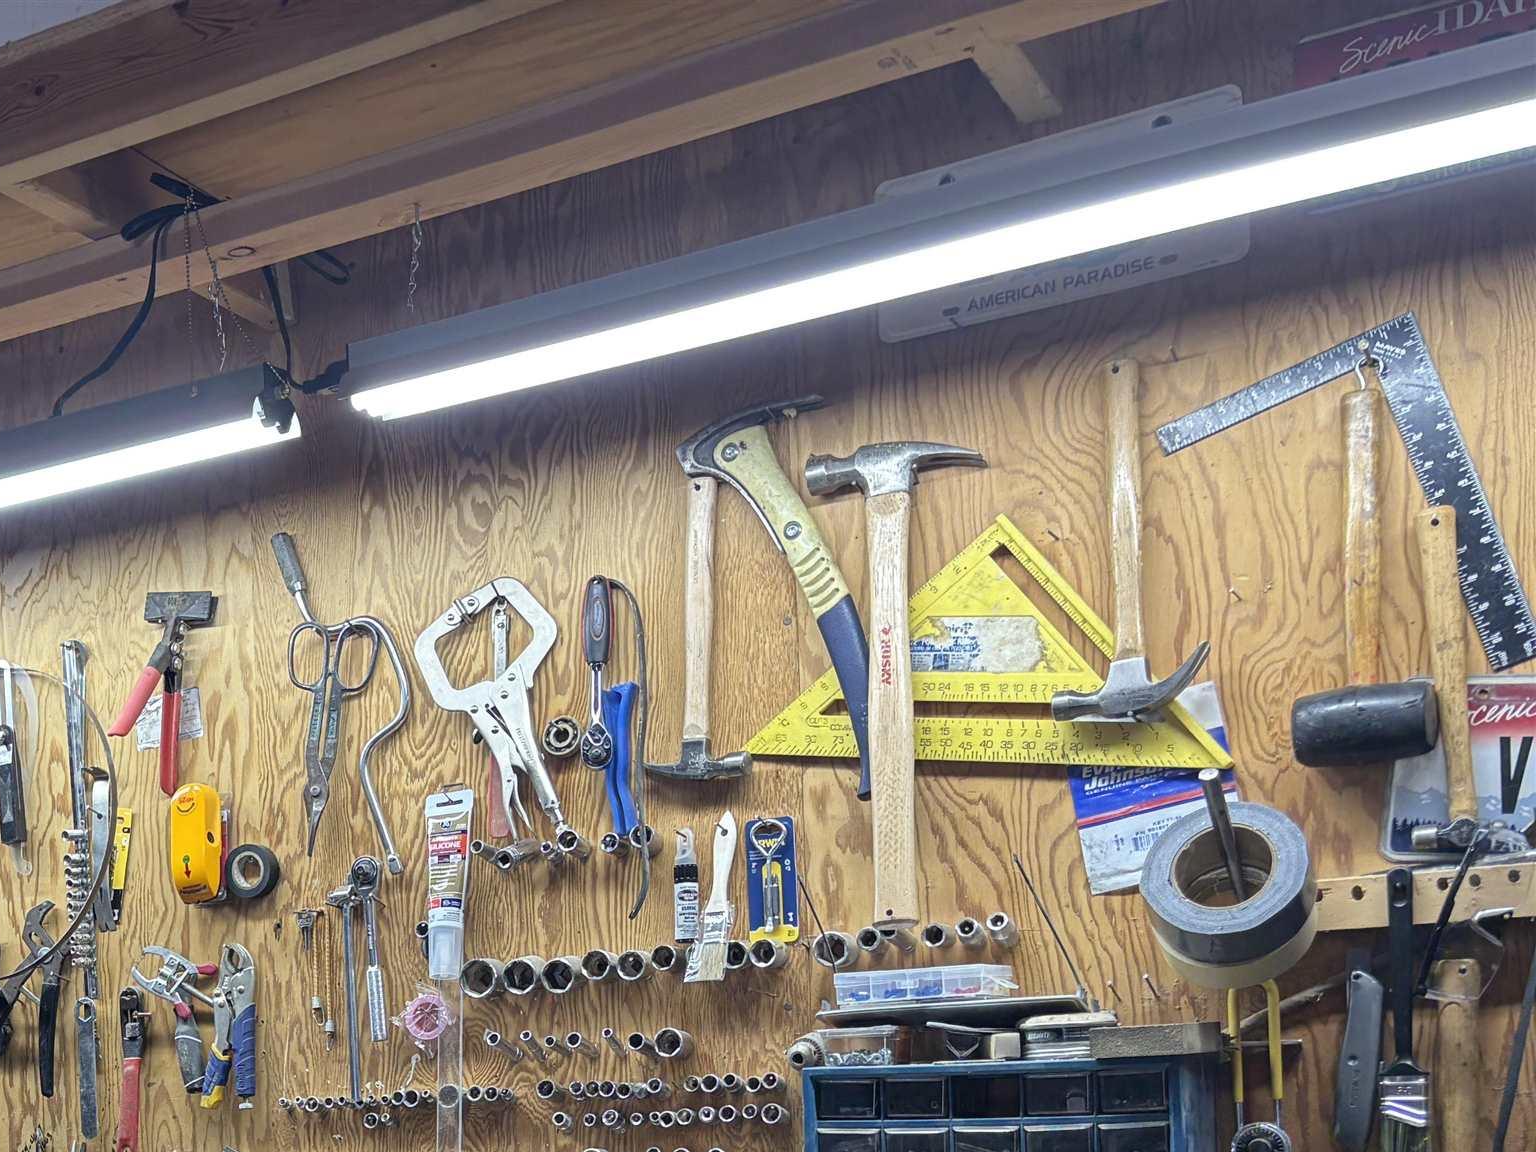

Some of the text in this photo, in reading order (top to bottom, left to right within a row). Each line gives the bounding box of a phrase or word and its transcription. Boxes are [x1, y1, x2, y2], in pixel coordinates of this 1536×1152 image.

[1339, 24, 1427, 73] Scenic
[967, 256, 1155, 312] AMERICAN PARADISE
[922, 682, 935, 691] 30
[939, 682, 951, 691] 24
[964, 683, 974, 691] 18
[980, 683, 990, 691] 15
[999, 683, 1008, 692] 12
[1014, 683, 1023, 692] 10
[1031, 684, 1037, 692] 8
[1042, 684, 1047, 692] 7
[1468, 697, 1536, 726] cenic
[920, 739, 932, 747] 55
[940, 739, 952, 747] 50
[958, 742, 972, 750] 45
[980, 740, 994, 749] 40
[1001, 741, 1013, 749] 35
[1022, 741, 1035, 749] 30
[1045, 742, 1057, 750] 25
[922, 727, 931, 735] 18
[940, 727, 949, 735] 15
[964, 728, 973, 736] 12
[983, 728, 993, 736] 10
[1053, 730, 1059, 738] 5
[1073, 730, 1080, 739] 4
[1096, 731, 1102, 739] 3
[1500, 737, 1533, 814] V
